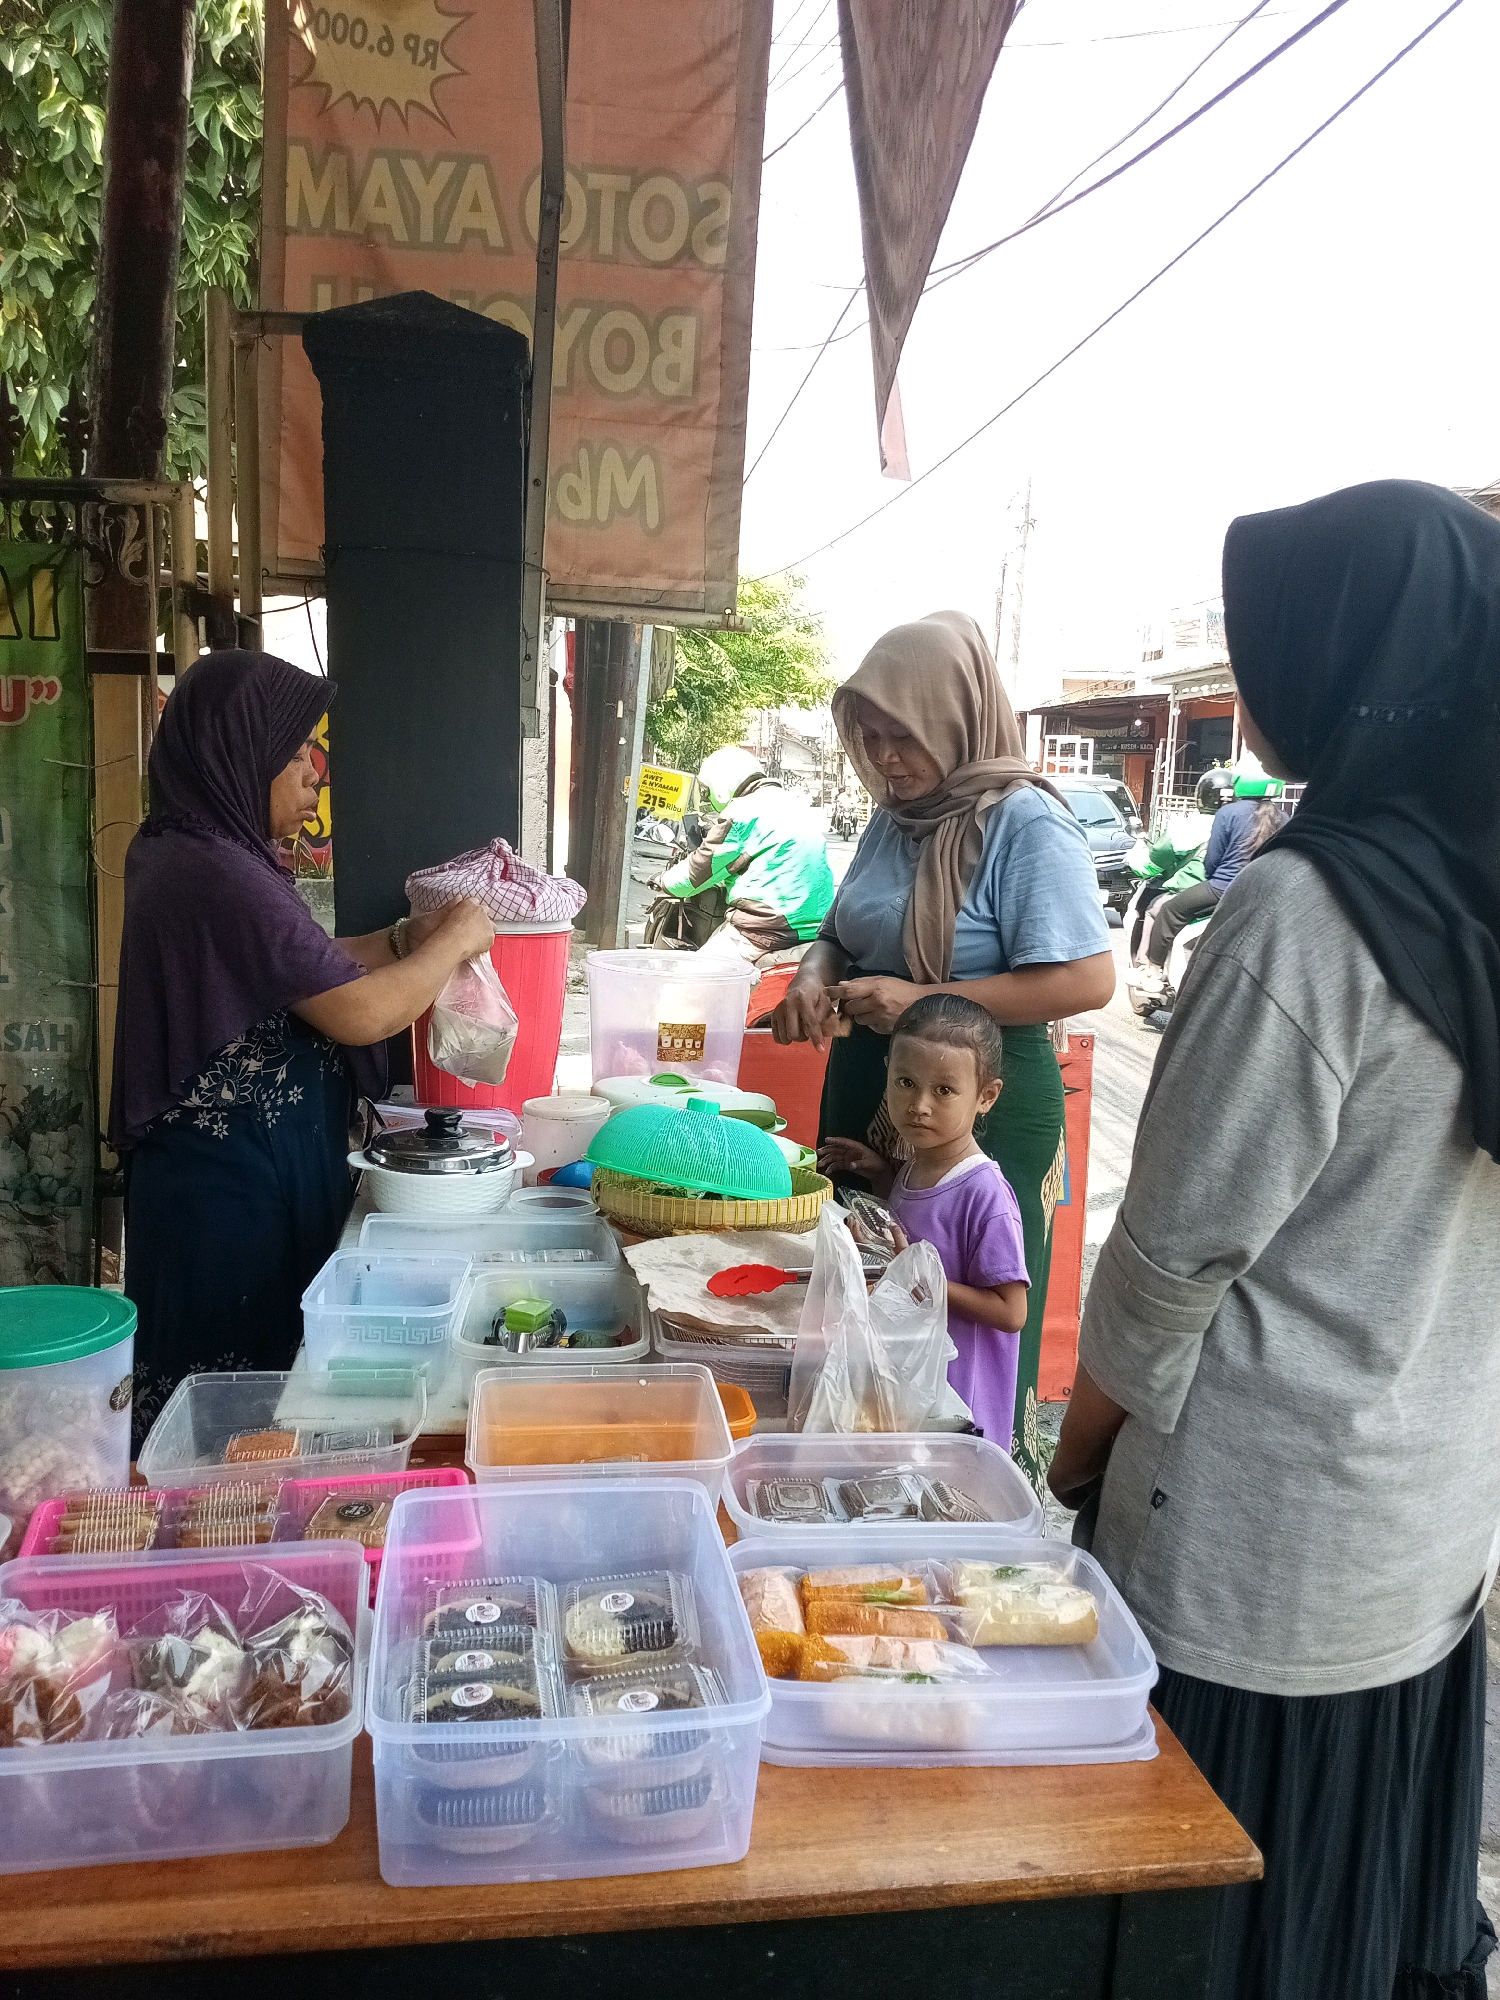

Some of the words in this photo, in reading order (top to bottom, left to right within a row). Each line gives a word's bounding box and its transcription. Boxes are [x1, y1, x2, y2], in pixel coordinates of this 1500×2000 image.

[643, 773, 663, 782] AWET
[648, 780, 679, 792] NYAMAN
[642, 793, 667, 808] 215
